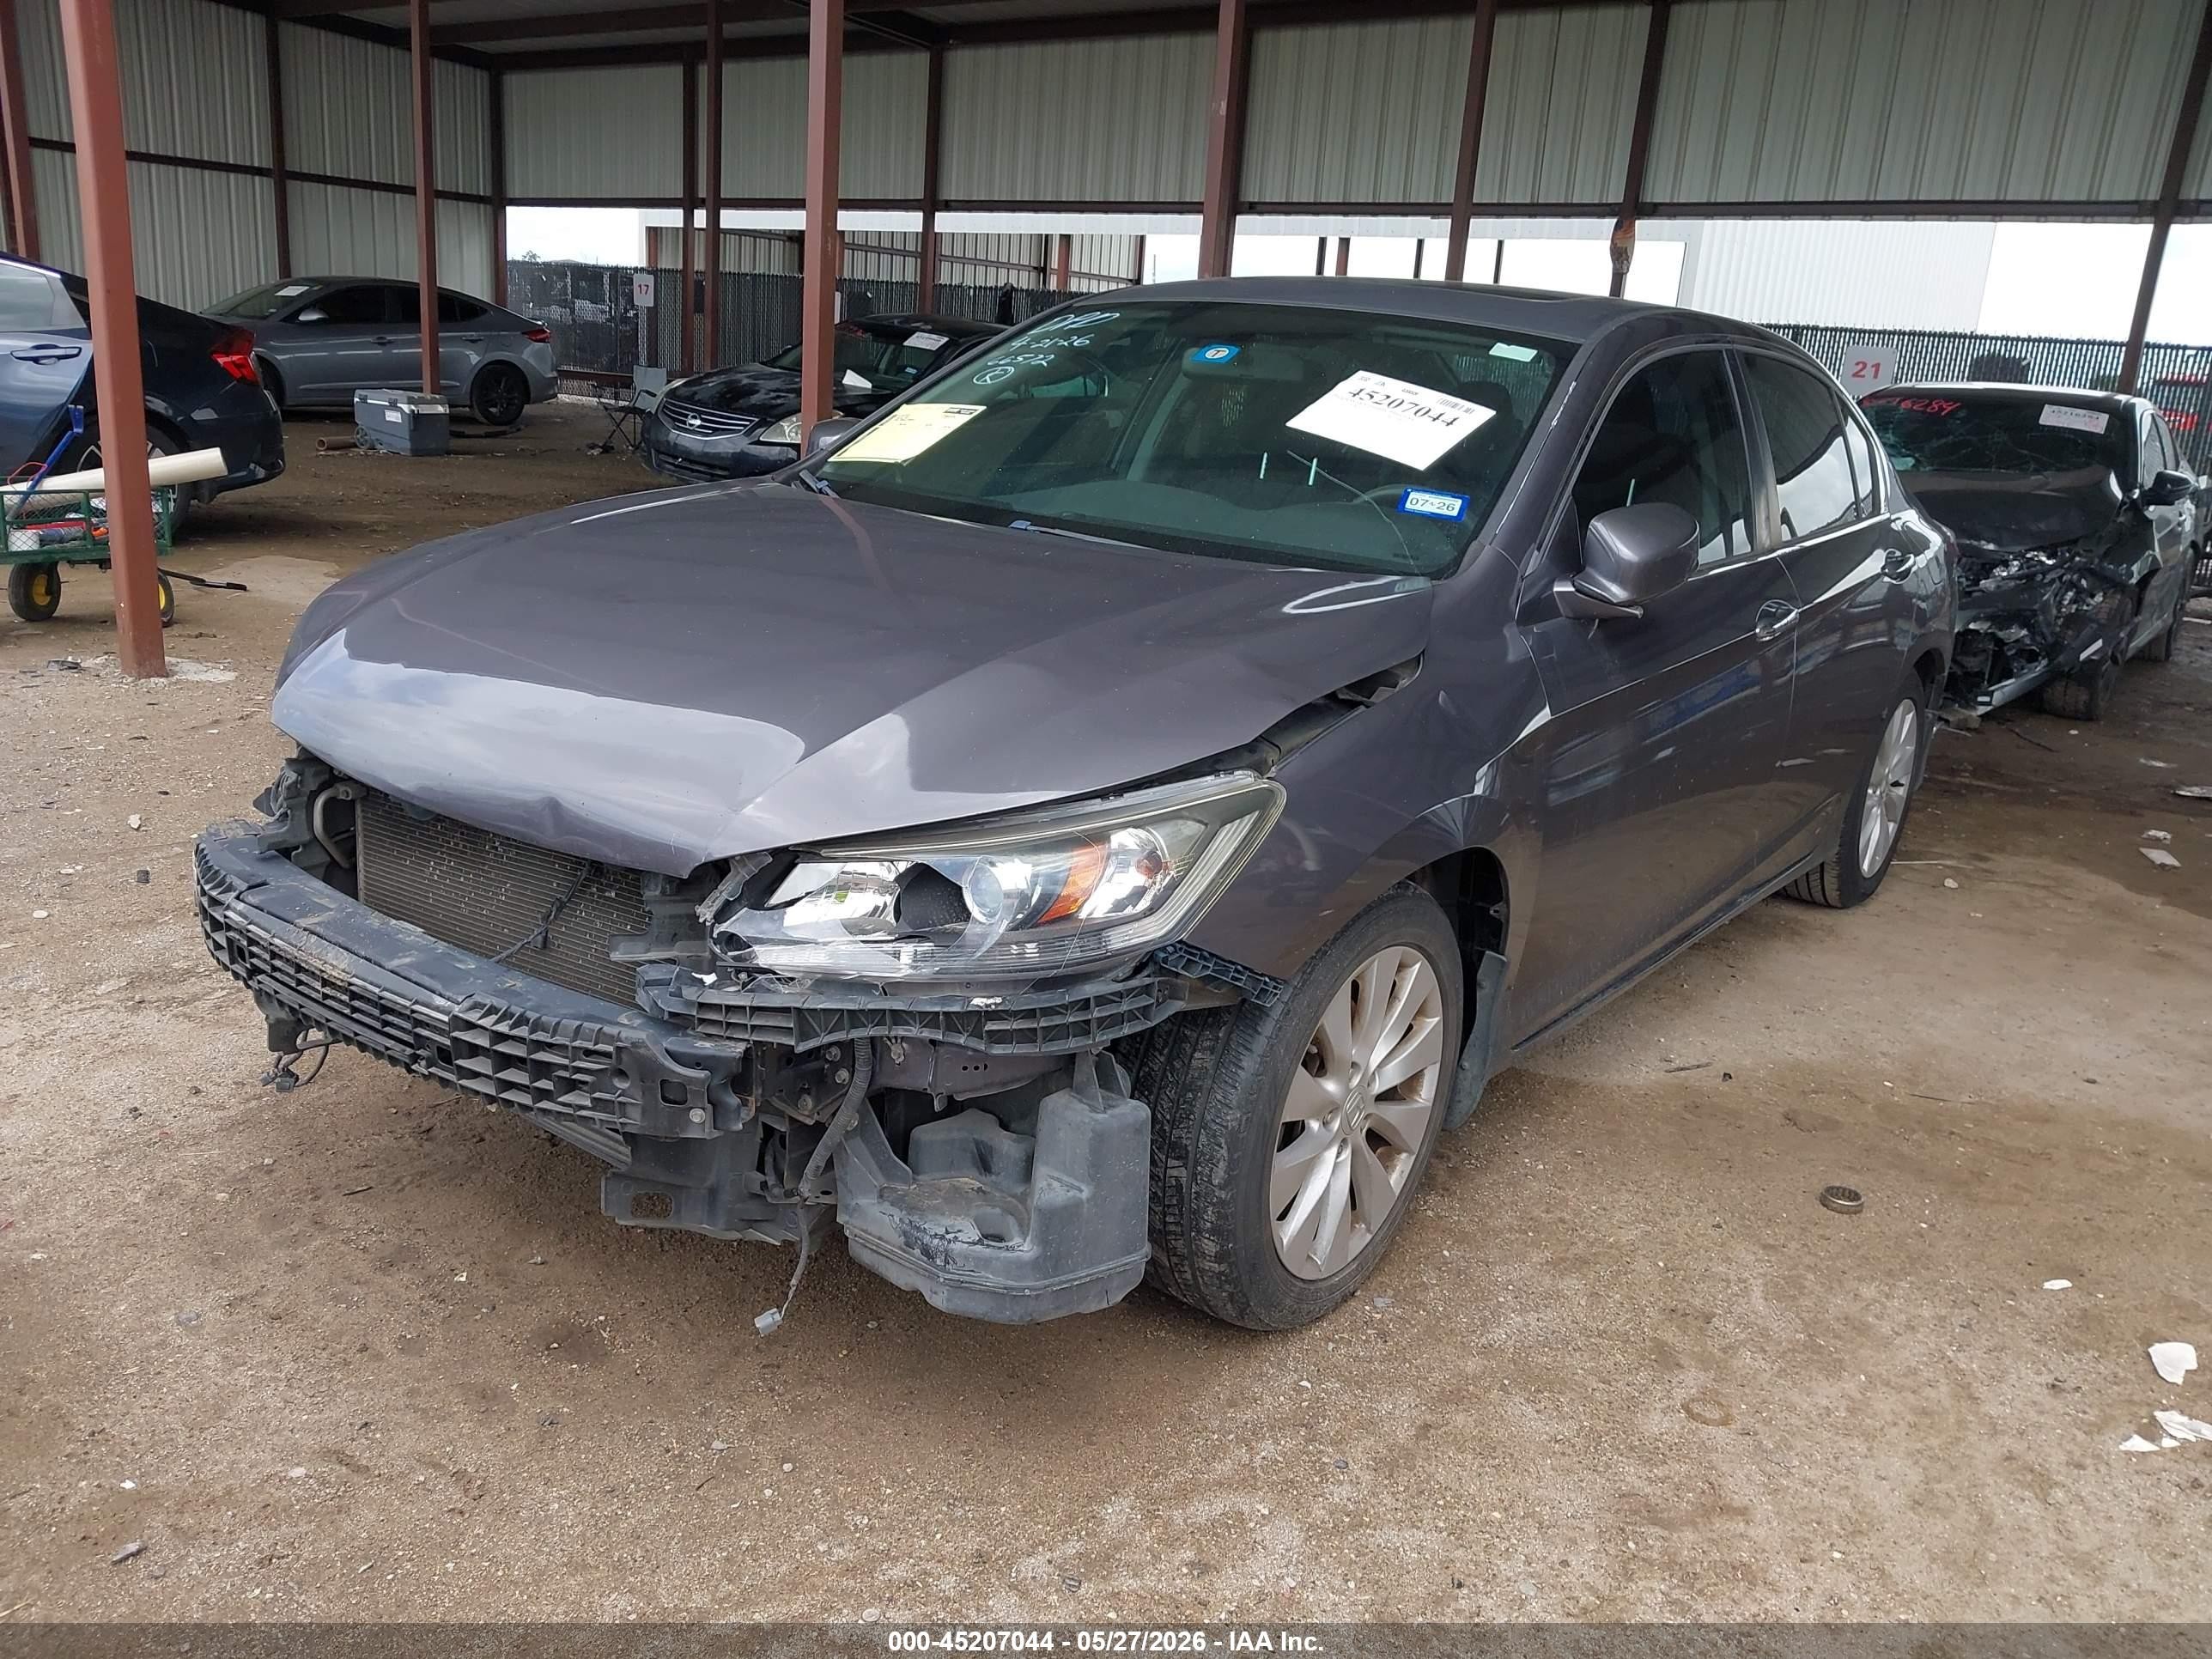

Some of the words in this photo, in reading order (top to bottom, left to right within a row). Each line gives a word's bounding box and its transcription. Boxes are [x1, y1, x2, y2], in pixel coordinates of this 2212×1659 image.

[638, 283, 649, 295] 17
[1851, 361, 1881, 380] 21
[1348, 387, 1460, 428] 45207044
